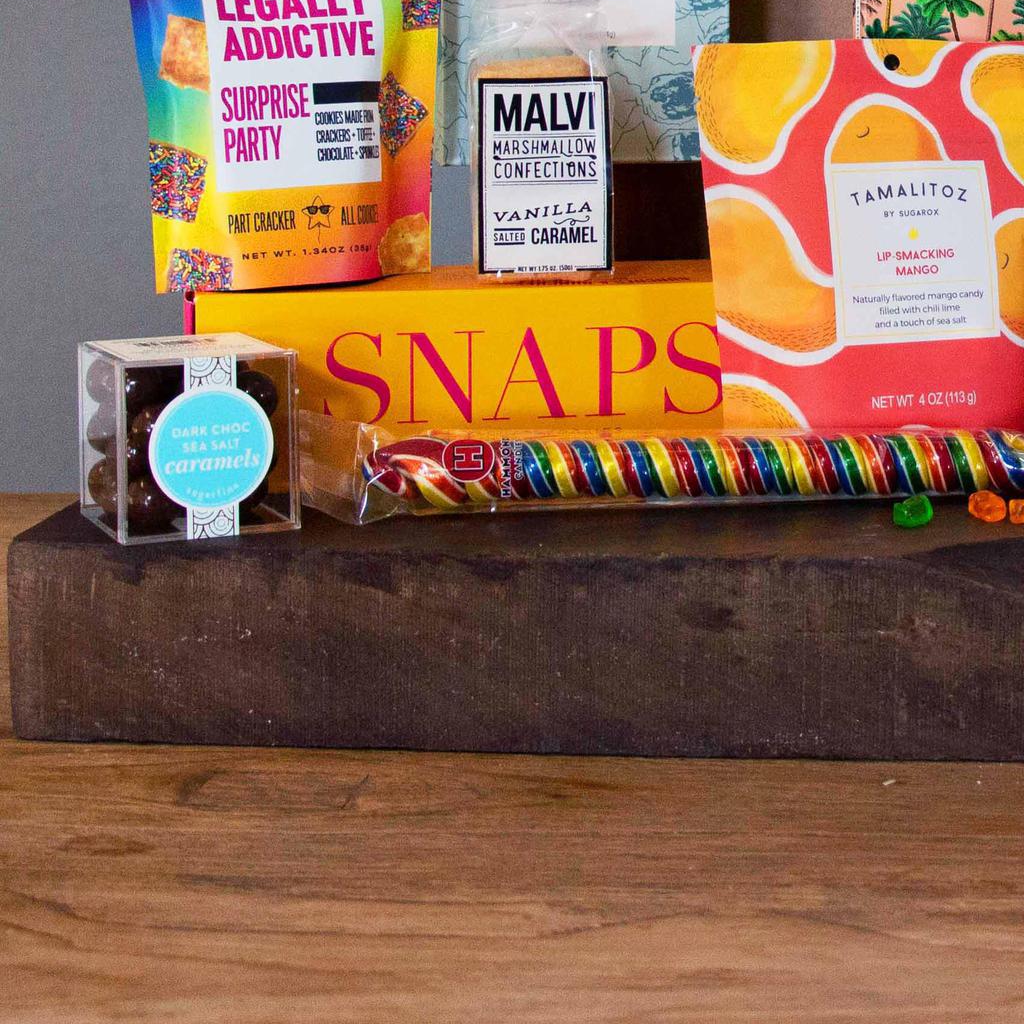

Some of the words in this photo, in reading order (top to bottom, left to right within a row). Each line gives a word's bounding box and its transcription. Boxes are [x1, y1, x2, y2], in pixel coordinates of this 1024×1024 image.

[223, 20, 376, 62] ADDICTIVE
[220, 82, 311, 123] SURPRISE
[315, 110, 344, 125] COOKIES
[345, 109, 363, 124] MADE
[493, 92, 595, 132] MALVI
[224, 124, 283, 164] PARTY
[316, 128, 351, 144] CRACKERS
[317, 146, 354, 162] CHOCOLATE
[493, 137, 596, 157] MARSHMALLOW
[494, 160, 597, 179] CONFECTIONS
[851, 182, 968, 206] TAMALITOZ
[228, 213, 251, 234] PART
[253, 209, 296, 233] CRACKER
[341, 206, 356, 226] ALL
[493, 202, 592, 222] VANILLA
[899, 209, 939, 217] SUGAROX
[493, 231, 525, 242] SALTED
[531, 226, 598, 244] CARAMEL
[242, 252, 267, 260] NET
[273, 250, 296, 258] WT.
[896, 265, 939, 276] MANGO
[853, 294, 890, 304] Naturally
[892, 293, 925, 302] flavored
[927, 291, 958, 301] mango
[960, 289, 984, 299] candy
[880, 306, 900, 315] filled
[901, 305, 920, 314] with
[922, 304, 940, 313] chili
[941, 303, 960, 312] lime
[875, 320, 891, 328] and
[900, 318, 924, 327] touch
[926, 317, 935, 325] of
[952, 315, 967, 324] salt
[324, 322, 722, 425] SNAPS
[871, 395, 894, 409] NET
[897, 394, 913, 407] WT
[918, 392, 925, 405] 4
[928, 391, 943, 405] OZ
[172, 425, 207, 438] DARK
[212, 422, 251, 435] CHOC
[183, 442, 207, 453] SEA
[211, 438, 239, 450] SALT
[165, 448, 260, 474] caramels
